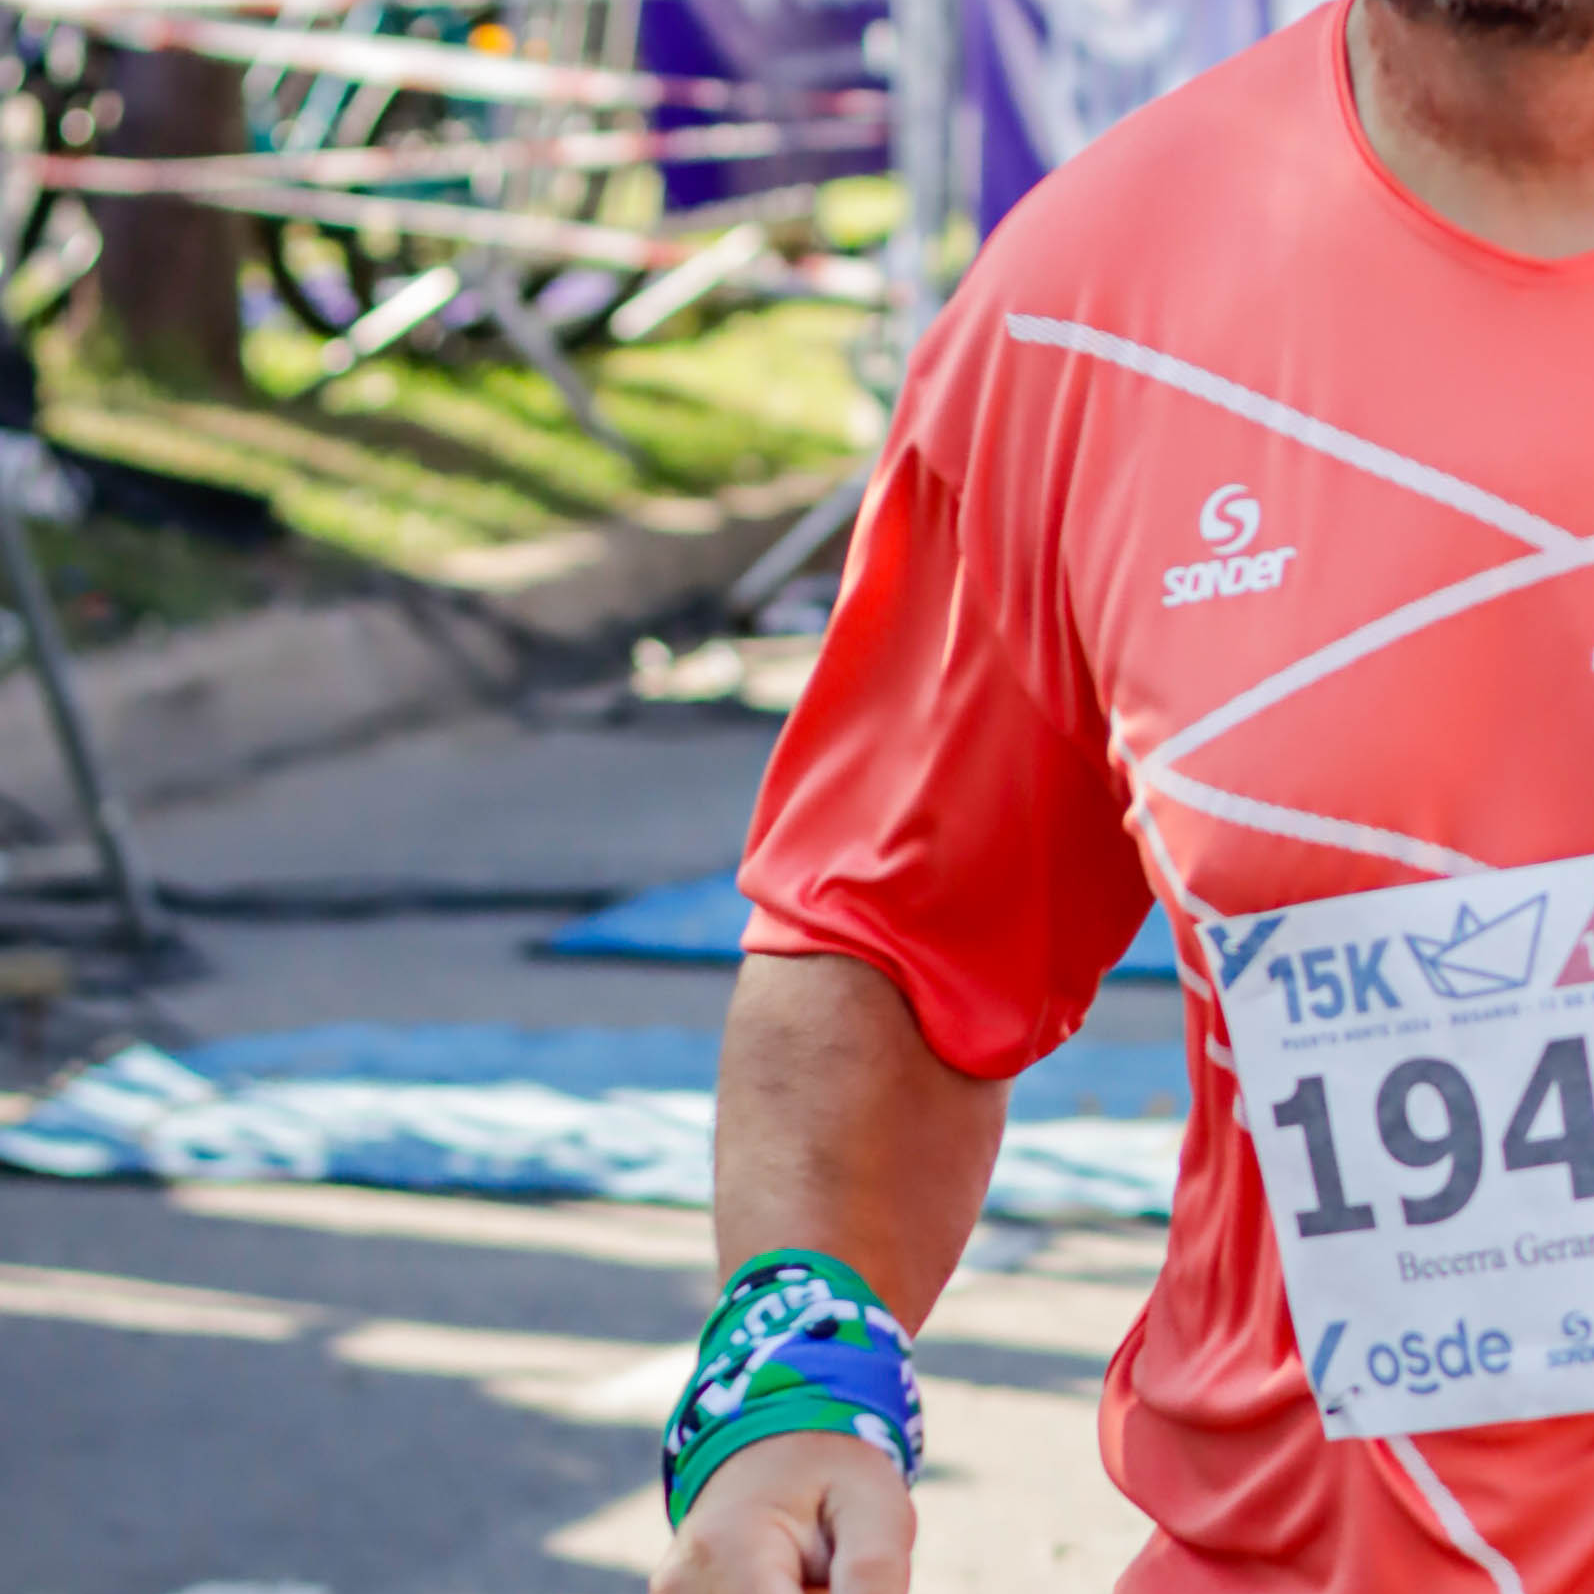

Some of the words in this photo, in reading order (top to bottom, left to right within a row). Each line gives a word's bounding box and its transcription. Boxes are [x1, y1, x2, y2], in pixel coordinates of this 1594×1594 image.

[1267, 936, 1404, 1024] 15K
[1397, 1247, 1507, 1283] Becerra
[1366, 1316, 1513, 1389] osde
